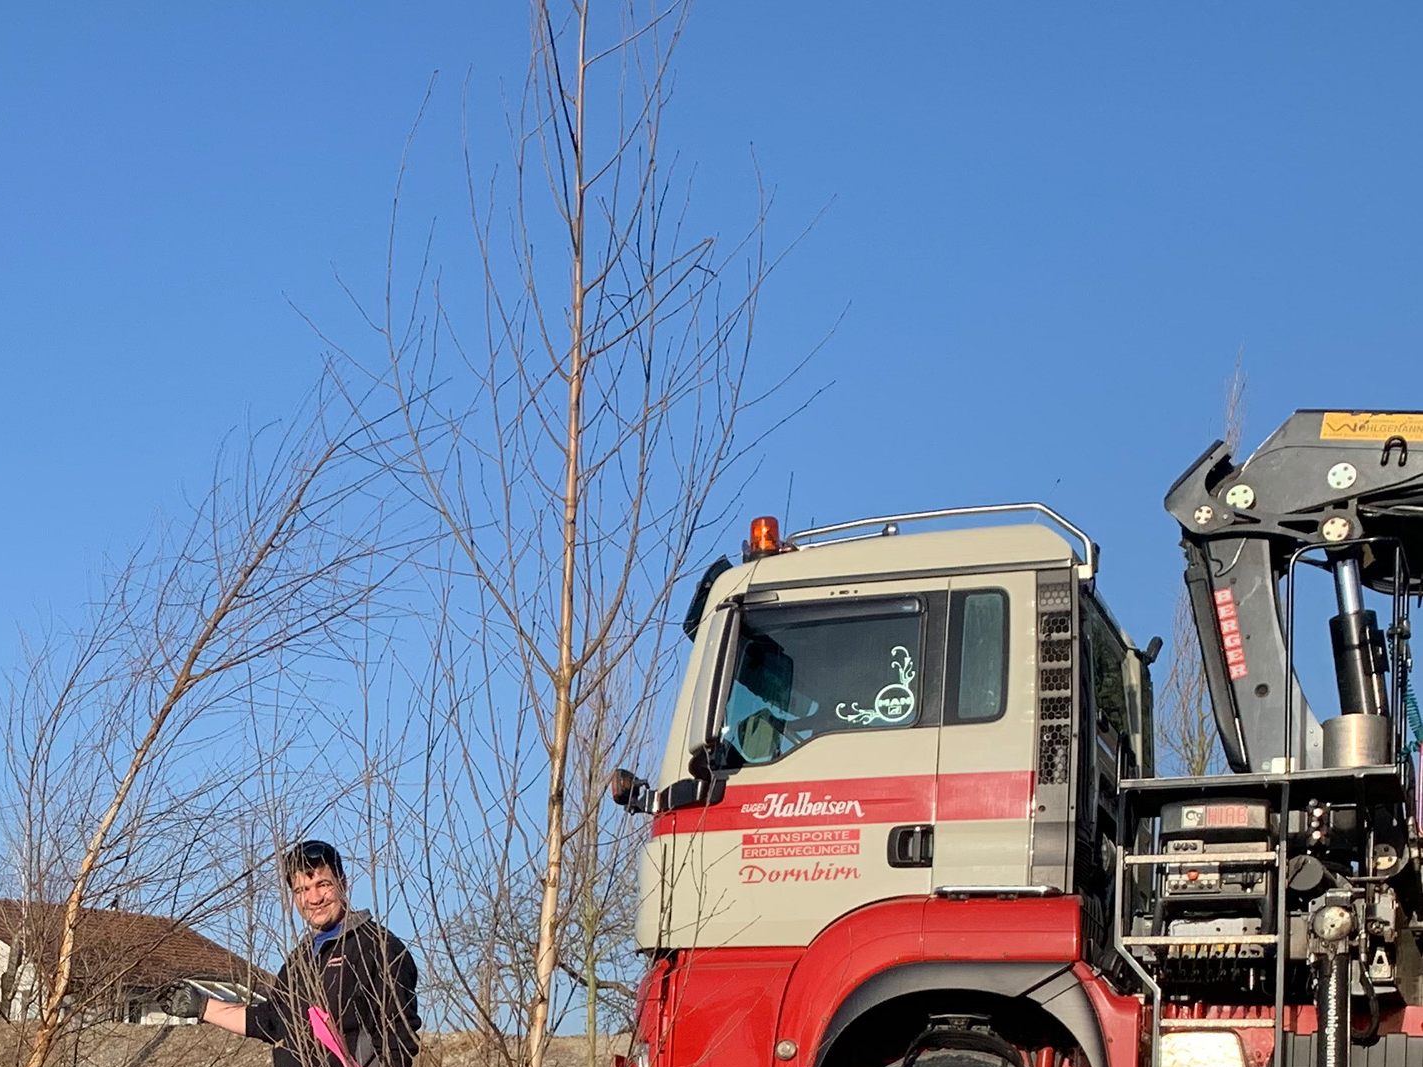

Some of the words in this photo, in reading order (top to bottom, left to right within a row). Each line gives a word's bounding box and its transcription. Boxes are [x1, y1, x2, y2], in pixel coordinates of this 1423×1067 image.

[1214, 587, 1248, 679] BERGER
[878, 698, 912, 707] MAN
[740, 803, 768, 814] EUGEN
[753, 792, 865, 819] Halbeisen
[1208, 806, 1247, 826] HIAB
[752, 830, 850, 844] TRANSPORTE
[743, 844, 858, 858] ERDBEWEGUNGEN
[738, 861, 862, 884] Dornbirn
